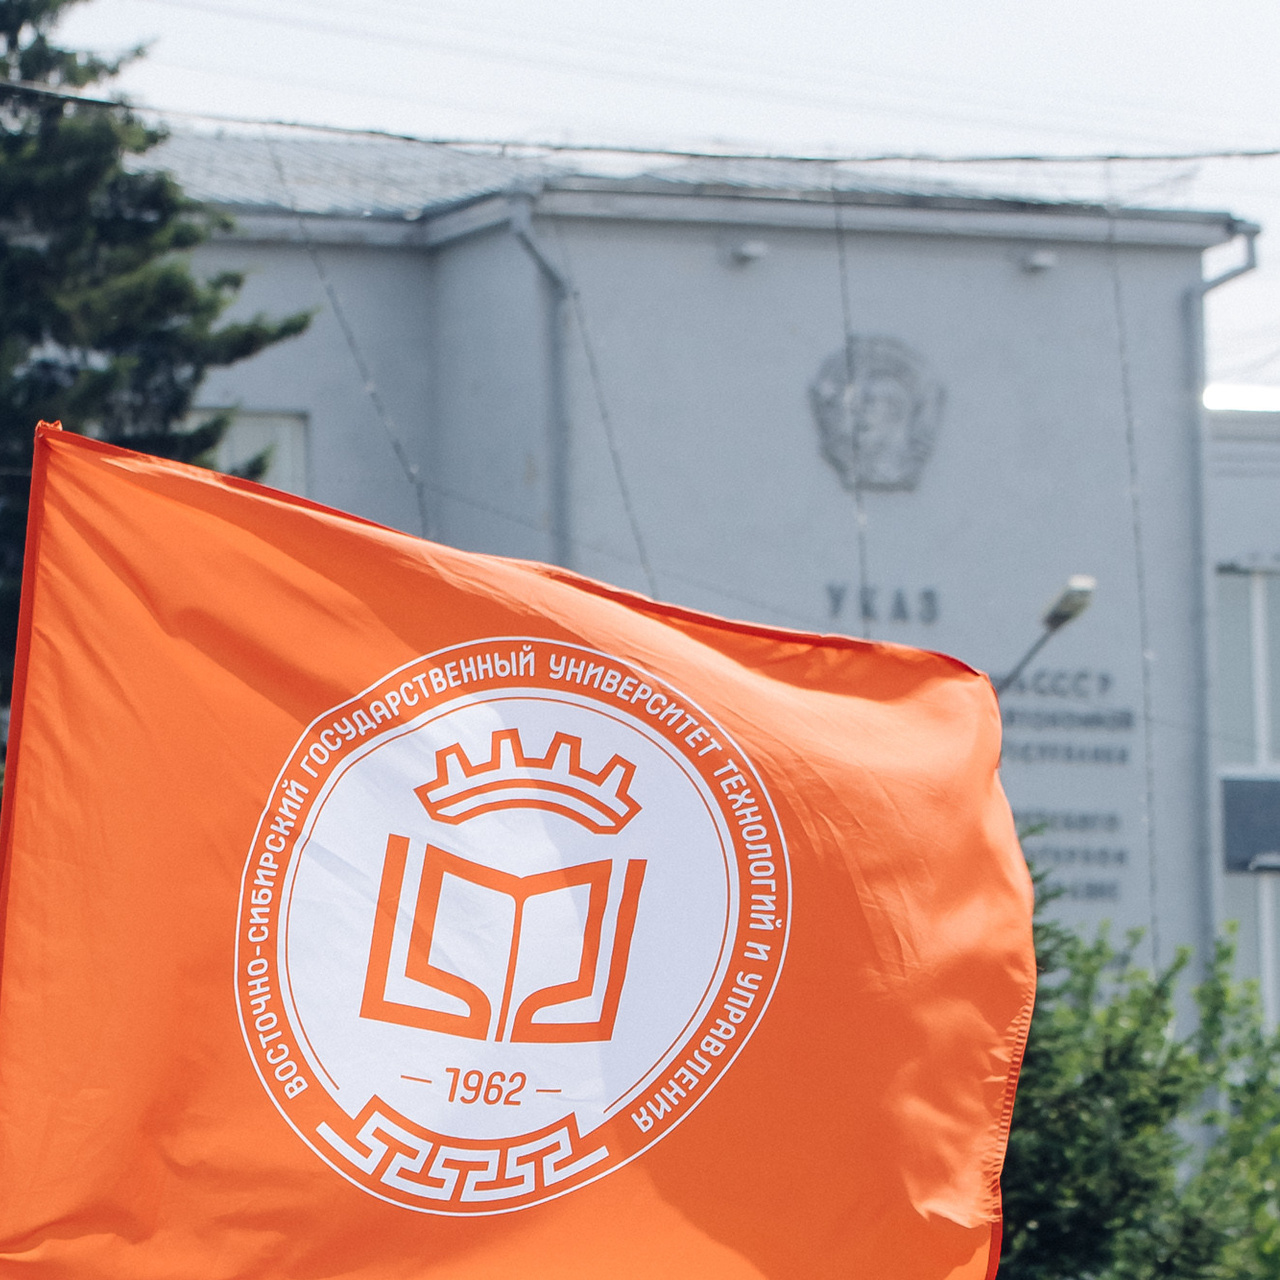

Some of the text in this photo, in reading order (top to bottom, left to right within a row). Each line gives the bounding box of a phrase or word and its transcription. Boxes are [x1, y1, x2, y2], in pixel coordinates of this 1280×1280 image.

[247, 645, 782, 1132] ВОСТОЧНО-СИБИРСКИЙ ГОСУДАРСТВЕННЫЙ УНИВЕРСИТЕТ ТЕХНОЛОГИЙ И УПРАВЛЕНИЯ
[445, 1067, 526, 1105] 1962
